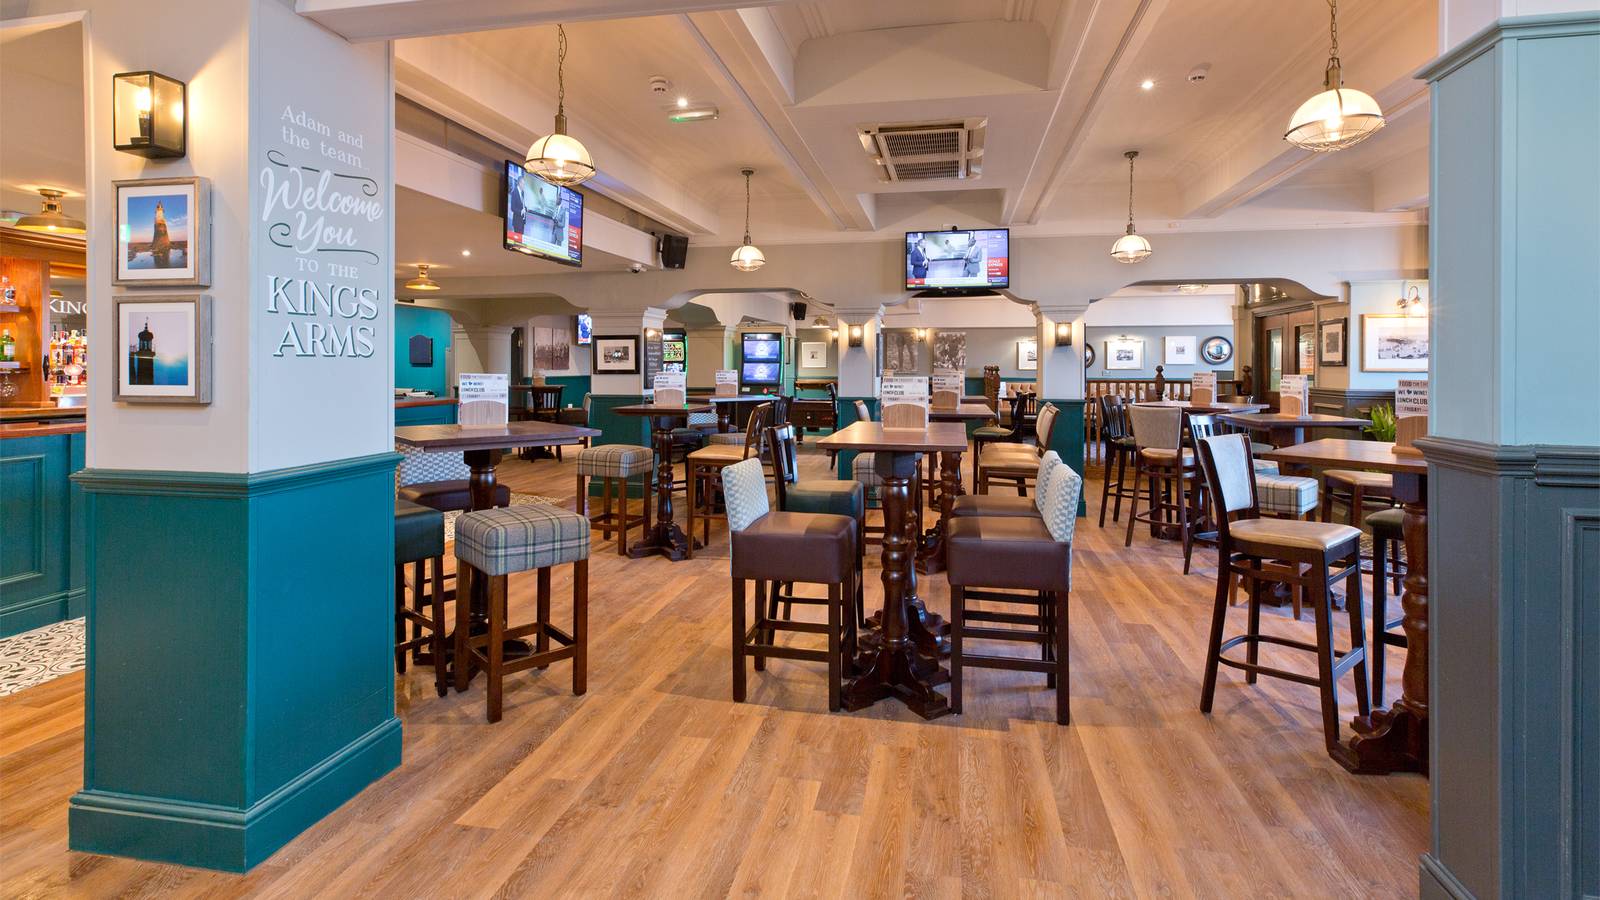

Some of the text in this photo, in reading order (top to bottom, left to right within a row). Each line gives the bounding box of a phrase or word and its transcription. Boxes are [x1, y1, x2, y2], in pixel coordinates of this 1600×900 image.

[281, 105, 363, 149] Adam and
[282, 125, 310, 150] the
[260, 167, 384, 222] Welcome
[294, 210, 358, 254] You
[295, 257, 359, 280] TO THE
[266, 274, 379, 320] KINGS
[272, 320, 376, 358] ARMS
[1412, 397, 1428, 405] CLUB
